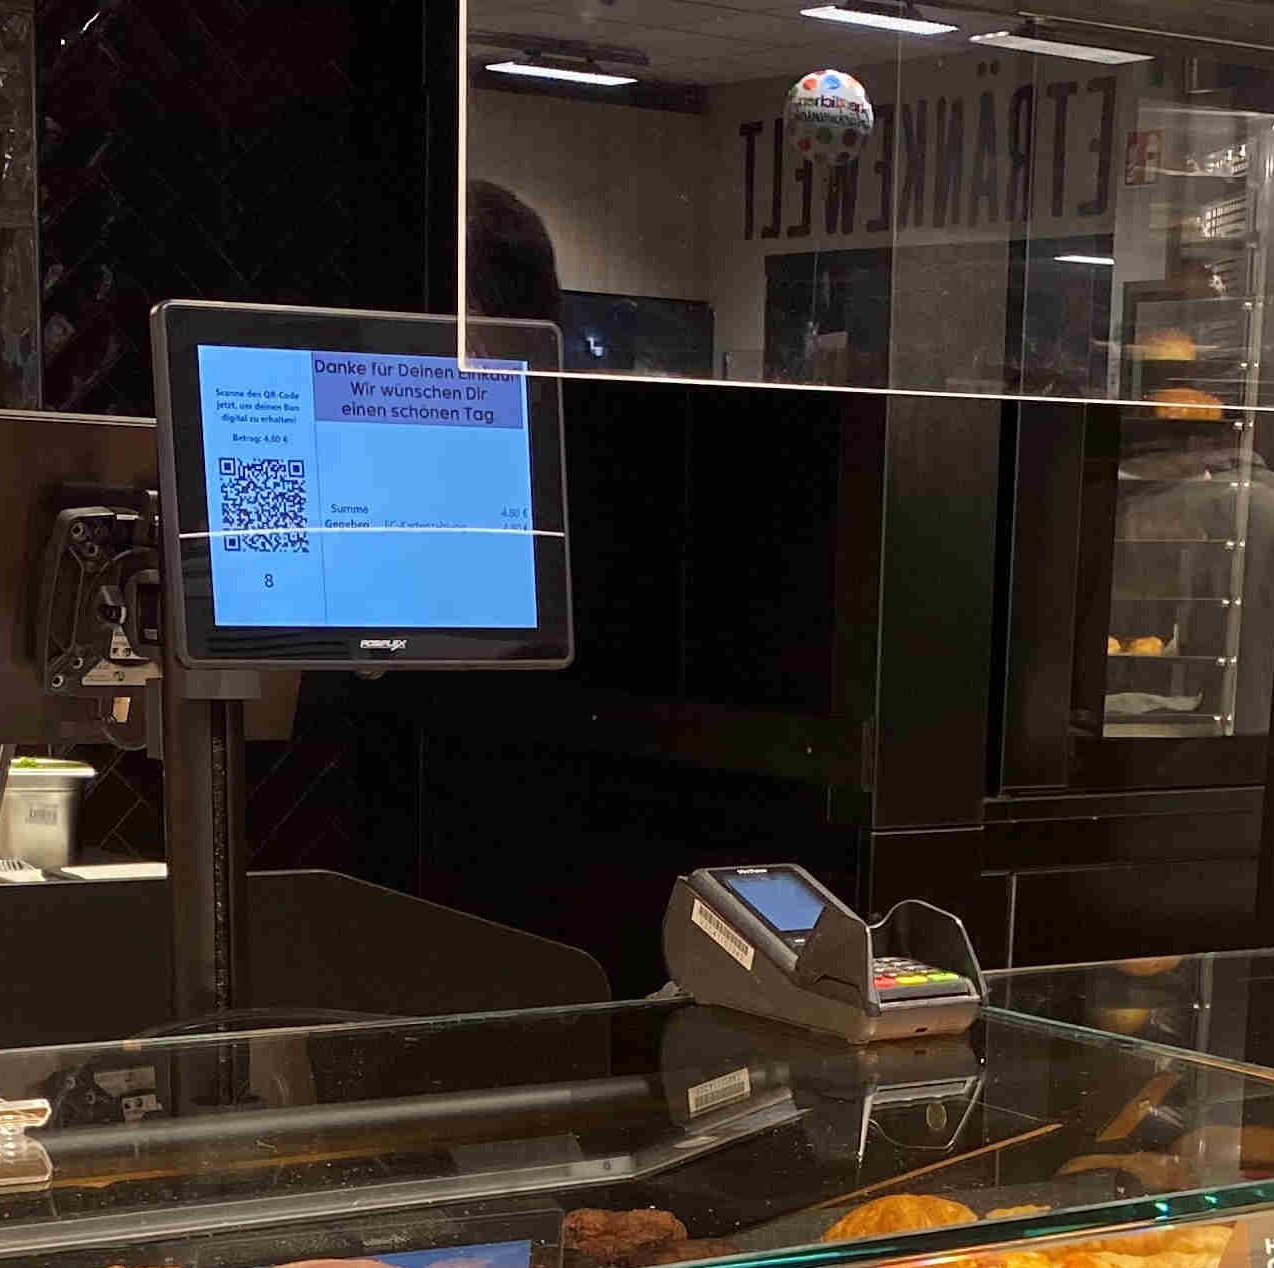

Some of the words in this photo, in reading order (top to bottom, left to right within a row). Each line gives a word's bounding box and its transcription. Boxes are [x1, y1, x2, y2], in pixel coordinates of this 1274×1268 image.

[315, 359, 367, 376] Danke
[371, 361, 393, 377] für
[398, 363, 454, 380] Deinen
[350, 381, 376, 397] Wir
[381, 382, 462, 400] wünschen
[466, 386, 488, 401] Dir
[341, 403, 387, 418] einen
[390, 404, 460, 421] schönen
[464, 407, 494, 425] Tag
[330, 503, 369, 515] Summe
[264, 573, 274, 588] 8
